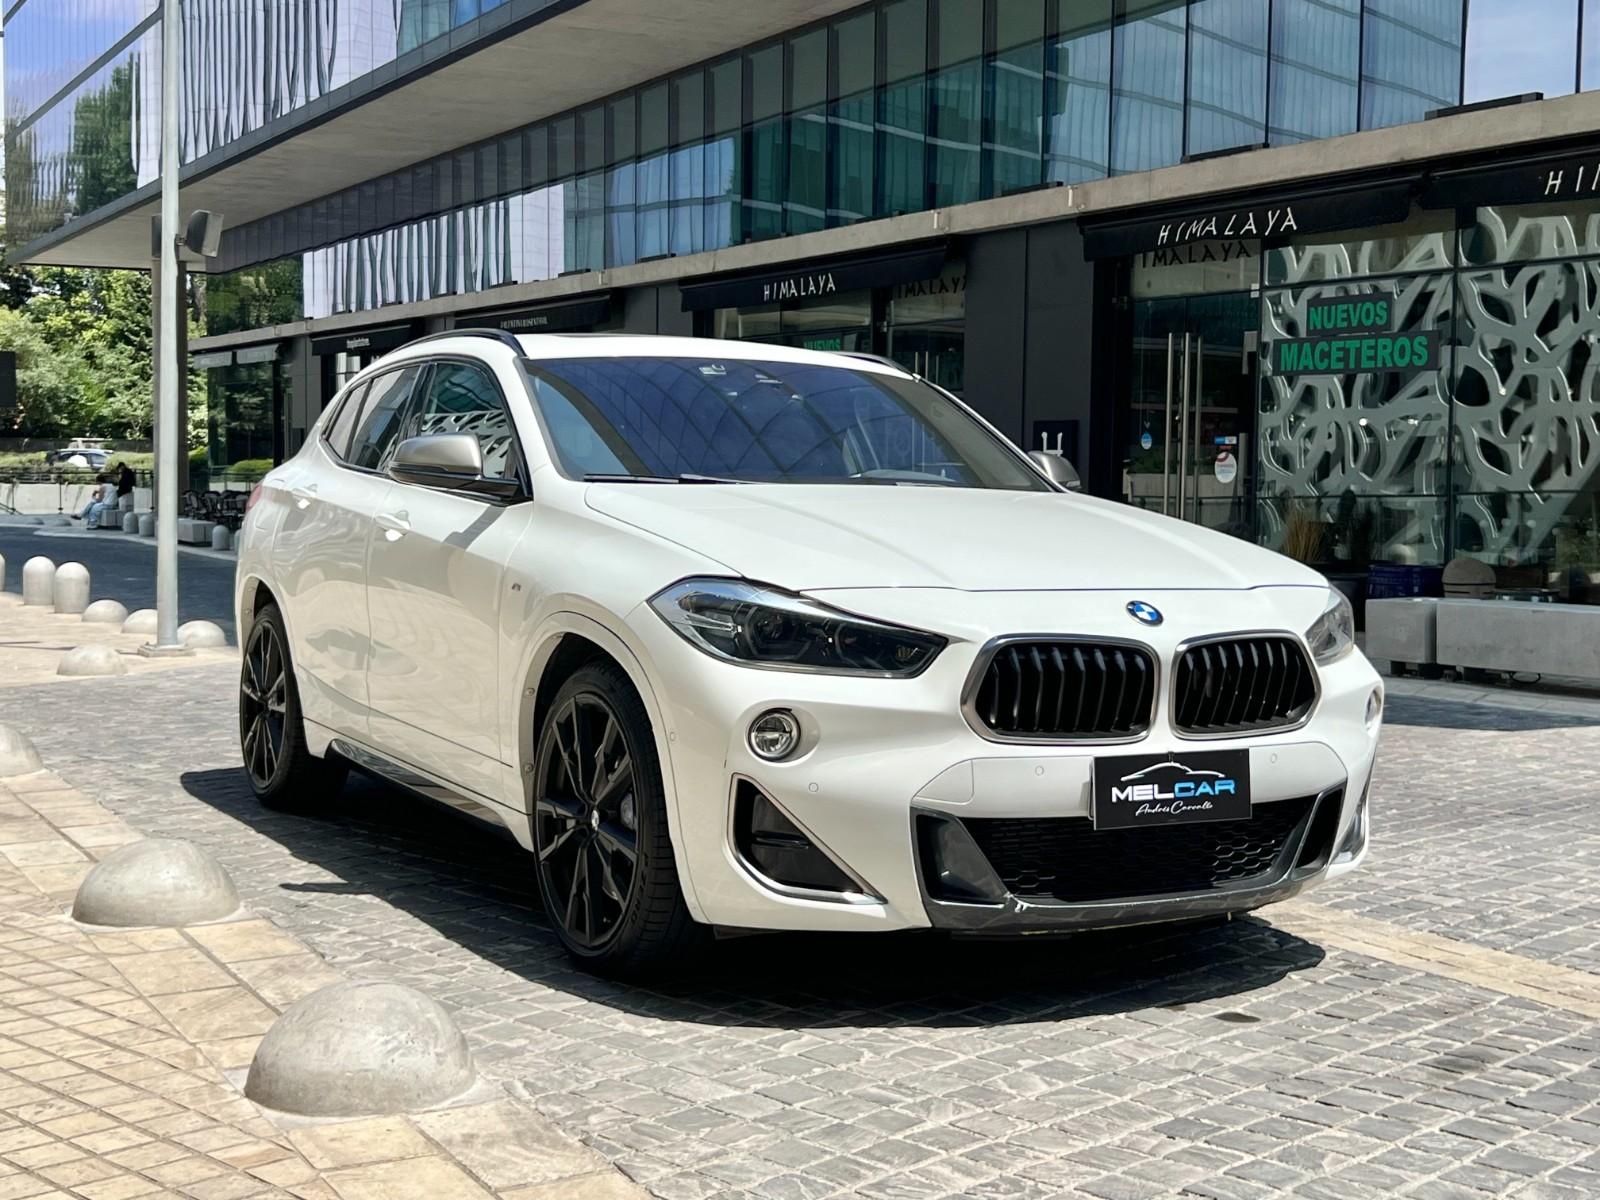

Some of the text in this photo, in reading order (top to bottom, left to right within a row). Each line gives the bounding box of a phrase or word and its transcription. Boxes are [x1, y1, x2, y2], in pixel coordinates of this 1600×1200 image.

[1157, 206, 1298, 246] HIMALAYA
[763, 272, 836, 302] HIMALAYA
[1309, 301, 1388, 330] NUEVOS
[1280, 335, 1428, 371] MACETEROS
[1111, 780, 1235, 803] MELCAR
